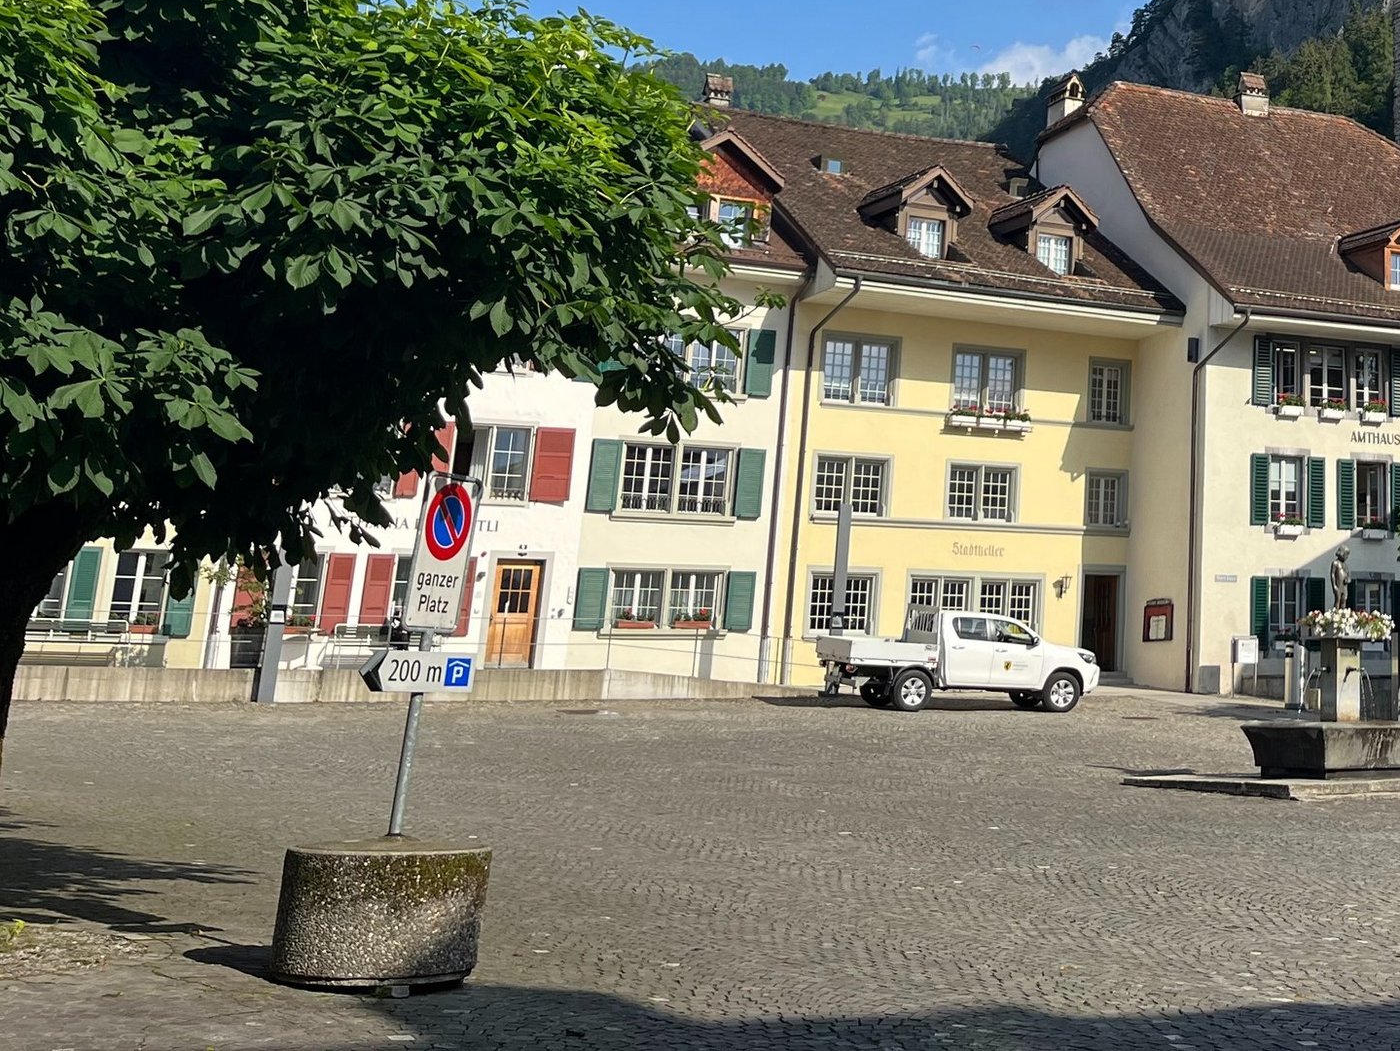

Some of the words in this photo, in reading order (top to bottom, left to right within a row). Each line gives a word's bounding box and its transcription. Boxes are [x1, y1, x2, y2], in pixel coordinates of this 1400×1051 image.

[1350, 431, 1400, 446] AMTHAUS
[416, 571, 459, 591] ganzer
[417, 594, 449, 614] Platz
[387, 659, 421, 682] 200
[426, 665, 442, 683] m
